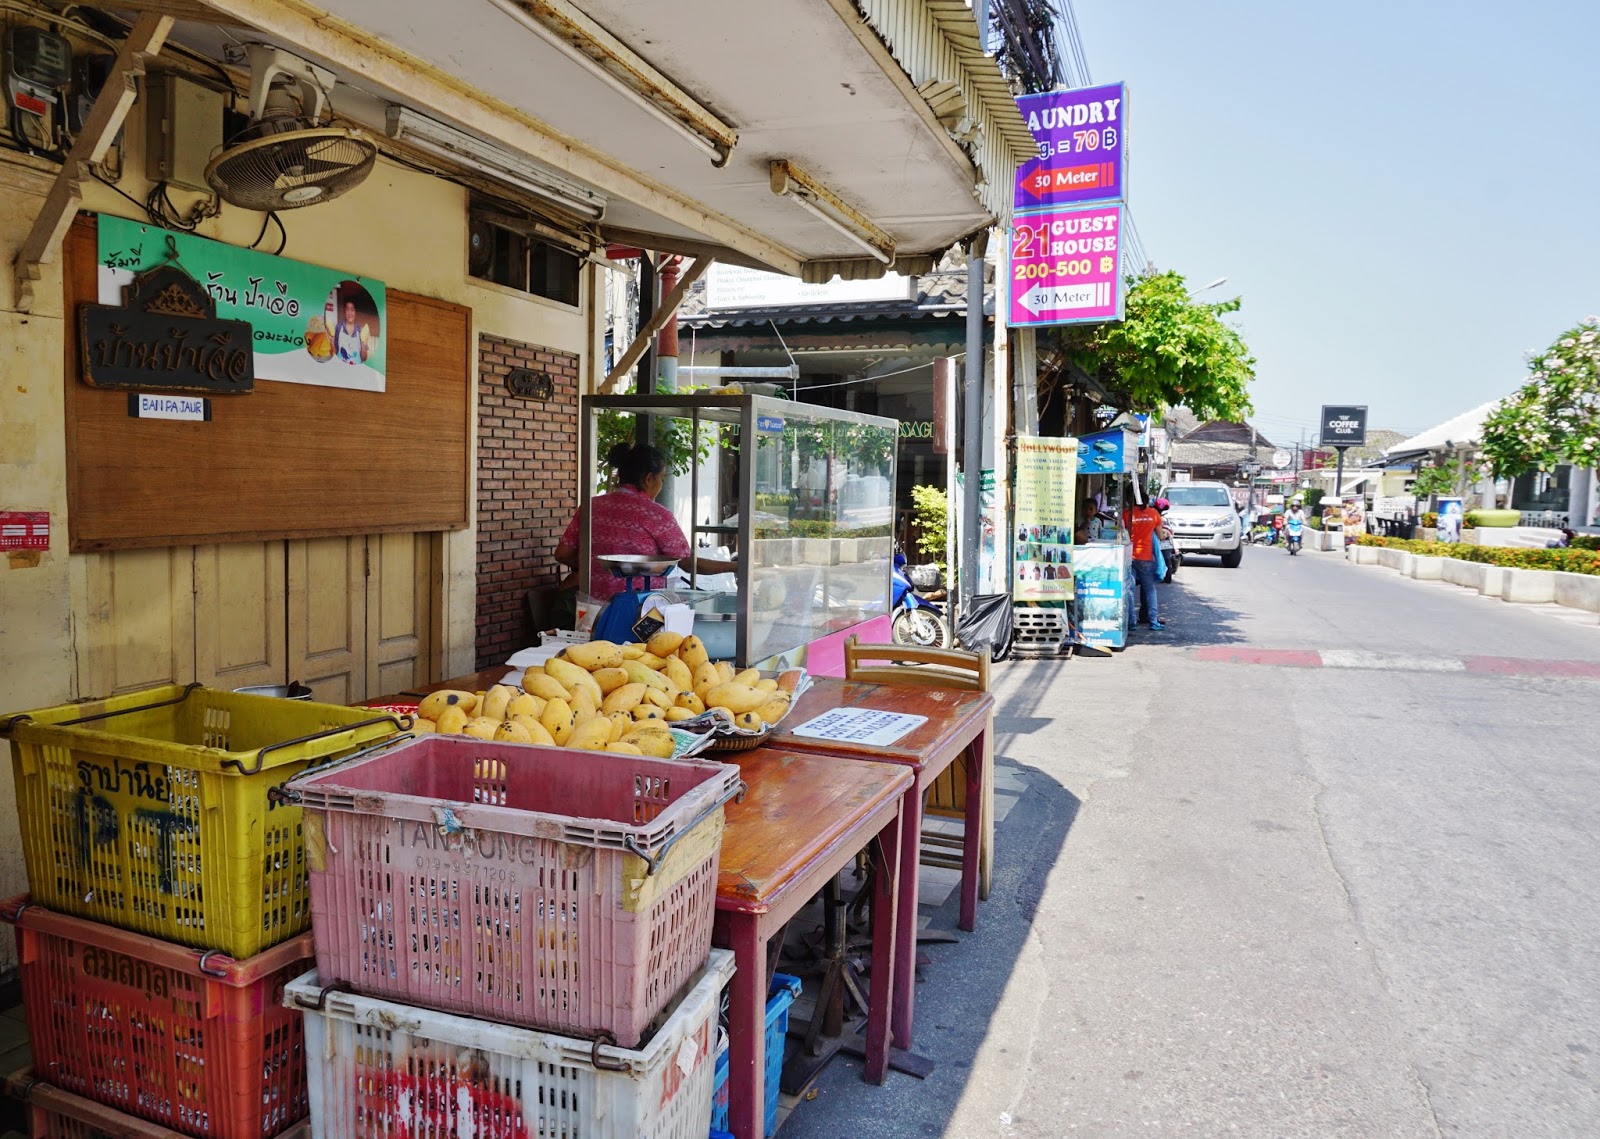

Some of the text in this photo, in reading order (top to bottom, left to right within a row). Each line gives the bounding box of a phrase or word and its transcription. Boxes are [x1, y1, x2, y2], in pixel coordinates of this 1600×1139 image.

[1028, 98, 1120, 131] AUNDRY
[1039, 141, 1055, 160] g.
[1073, 129, 1099, 152] 70
[1034, 170, 1098, 188] 30 Meter
[1012, 215, 1117, 259] 21 GUEST
[1050, 236, 1117, 256] HOUSE
[1014, 259, 1092, 280] 200-500
[1034, 291, 1091, 305] 30 Meter
[165, 400, 178, 413] PA
[1329, 420, 1359, 428] COFFEE
[1020, 443, 1077, 454] HOLLYWOOD
[393, 819, 536, 867] TANONG
